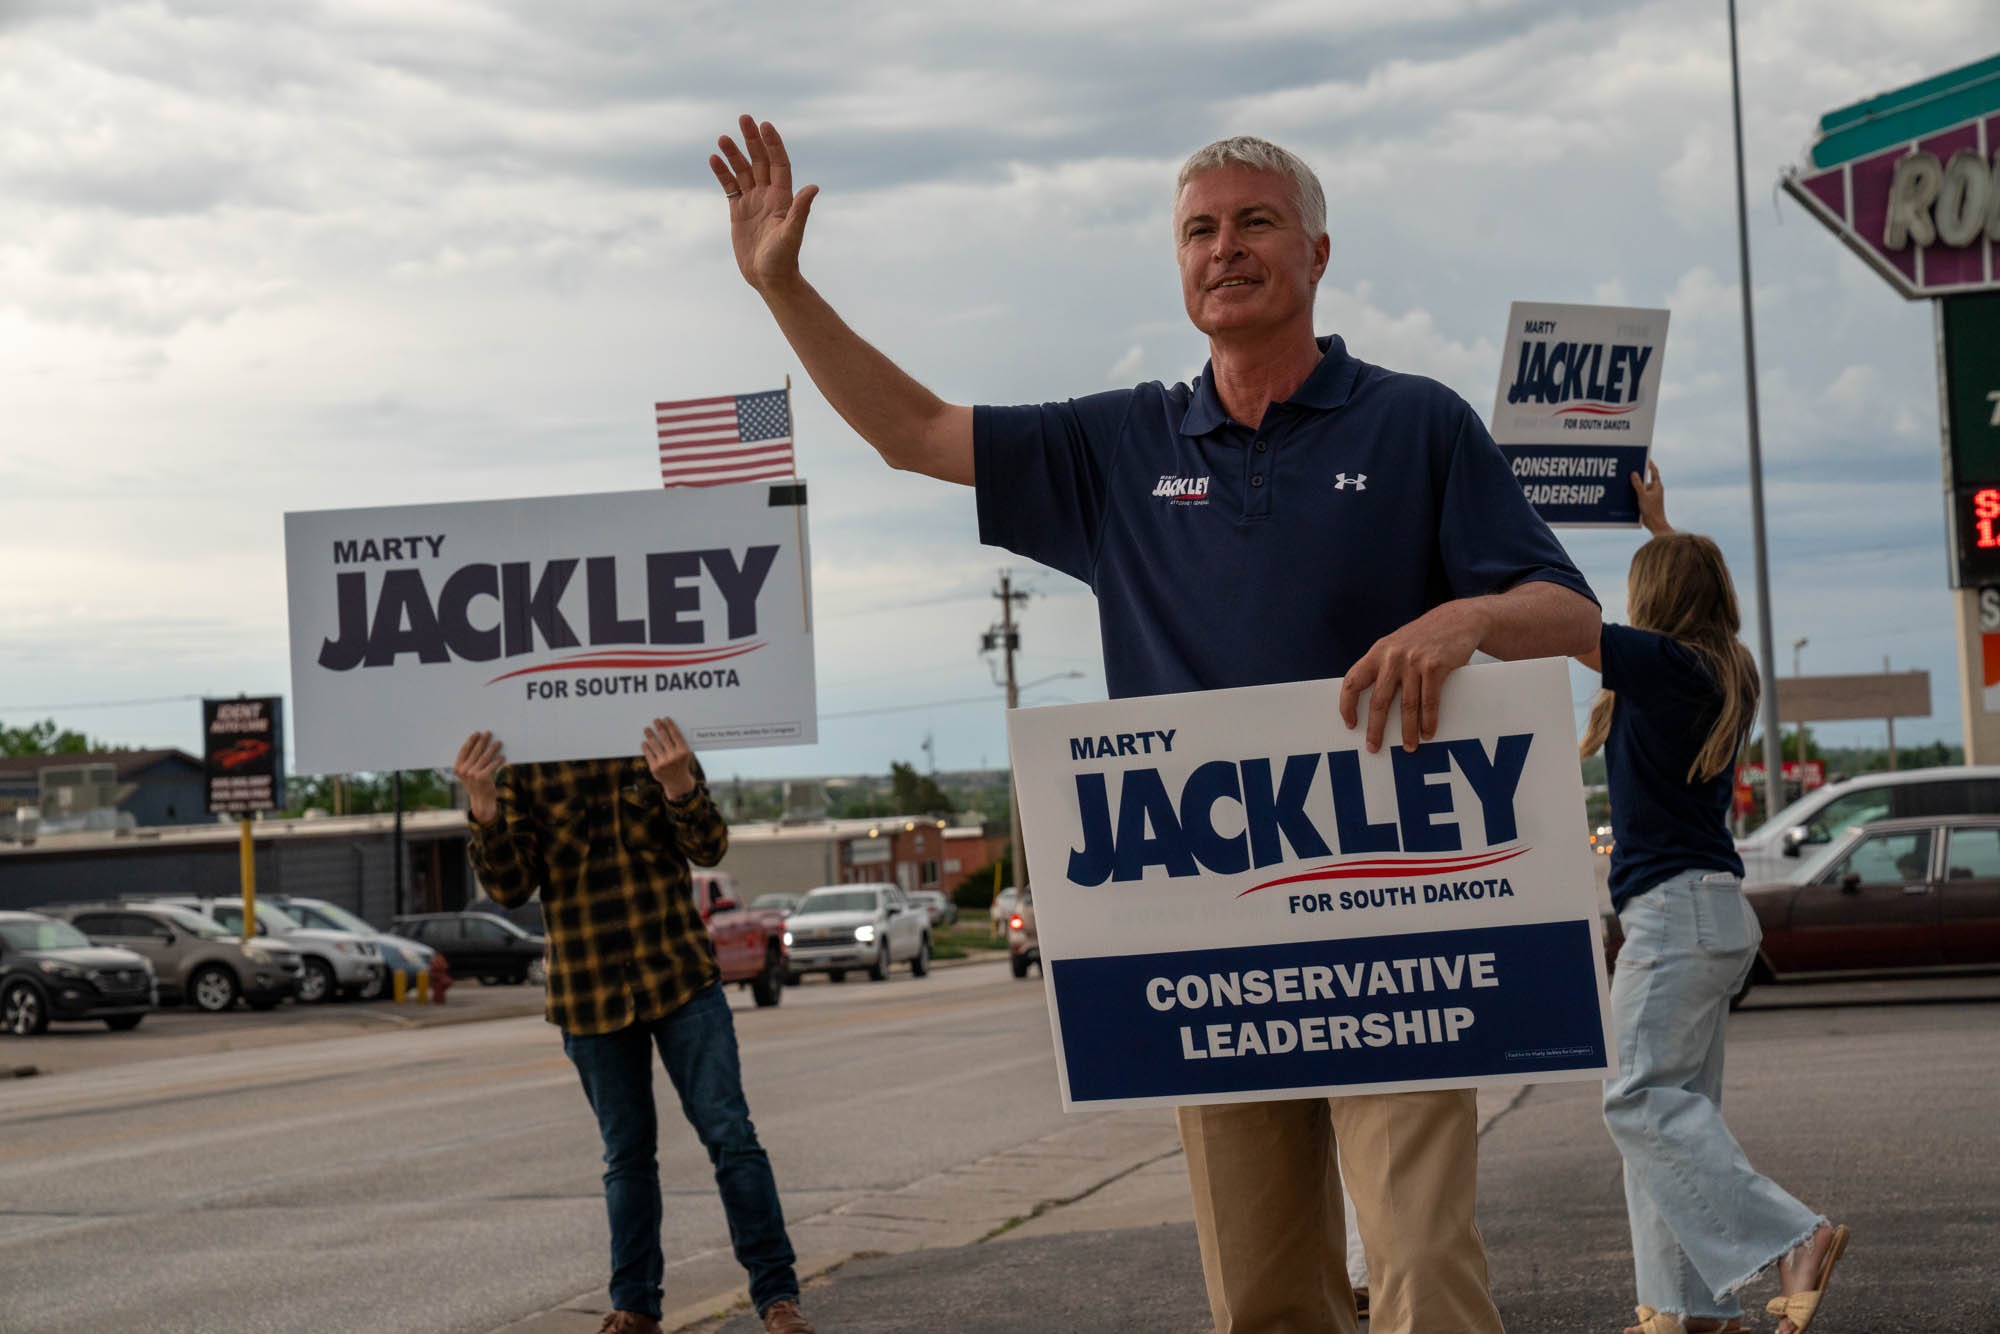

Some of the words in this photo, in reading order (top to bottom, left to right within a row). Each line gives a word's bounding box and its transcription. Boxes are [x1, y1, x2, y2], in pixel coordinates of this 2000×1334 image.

[1524, 320, 1557, 334] MARTY
[1507, 340, 1653, 404] JACKLEY
[1563, 418, 1578, 430] FOR
[1579, 419, 1602, 431] SOUTH
[1603, 419, 1630, 431] DAKOTA
[1511, 456, 1618, 477] CONSERVATIVE
[1152, 476, 1210, 496] JACKLEY
[1522, 484, 1605, 504] EADERSHIP
[333, 534, 446, 564] MARTY
[317, 544, 781, 672] JACKLEY
[526, 679, 569, 701] FOR
[575, 674, 648, 697] SOUTH
[655, 668, 741, 692] DAKOTA
[1069, 729, 1177, 760] MARTY
[1066, 733, 1535, 887] JACKLEY
[1288, 893, 1334, 914] FOR
[1339, 886, 1417, 911] SOUTH
[1422, 878, 1515, 904] DAKOTA
[1145, 952, 1500, 1012] CONSERVATIVE
[1179, 1006, 1476, 1061] LEADERSHIP
